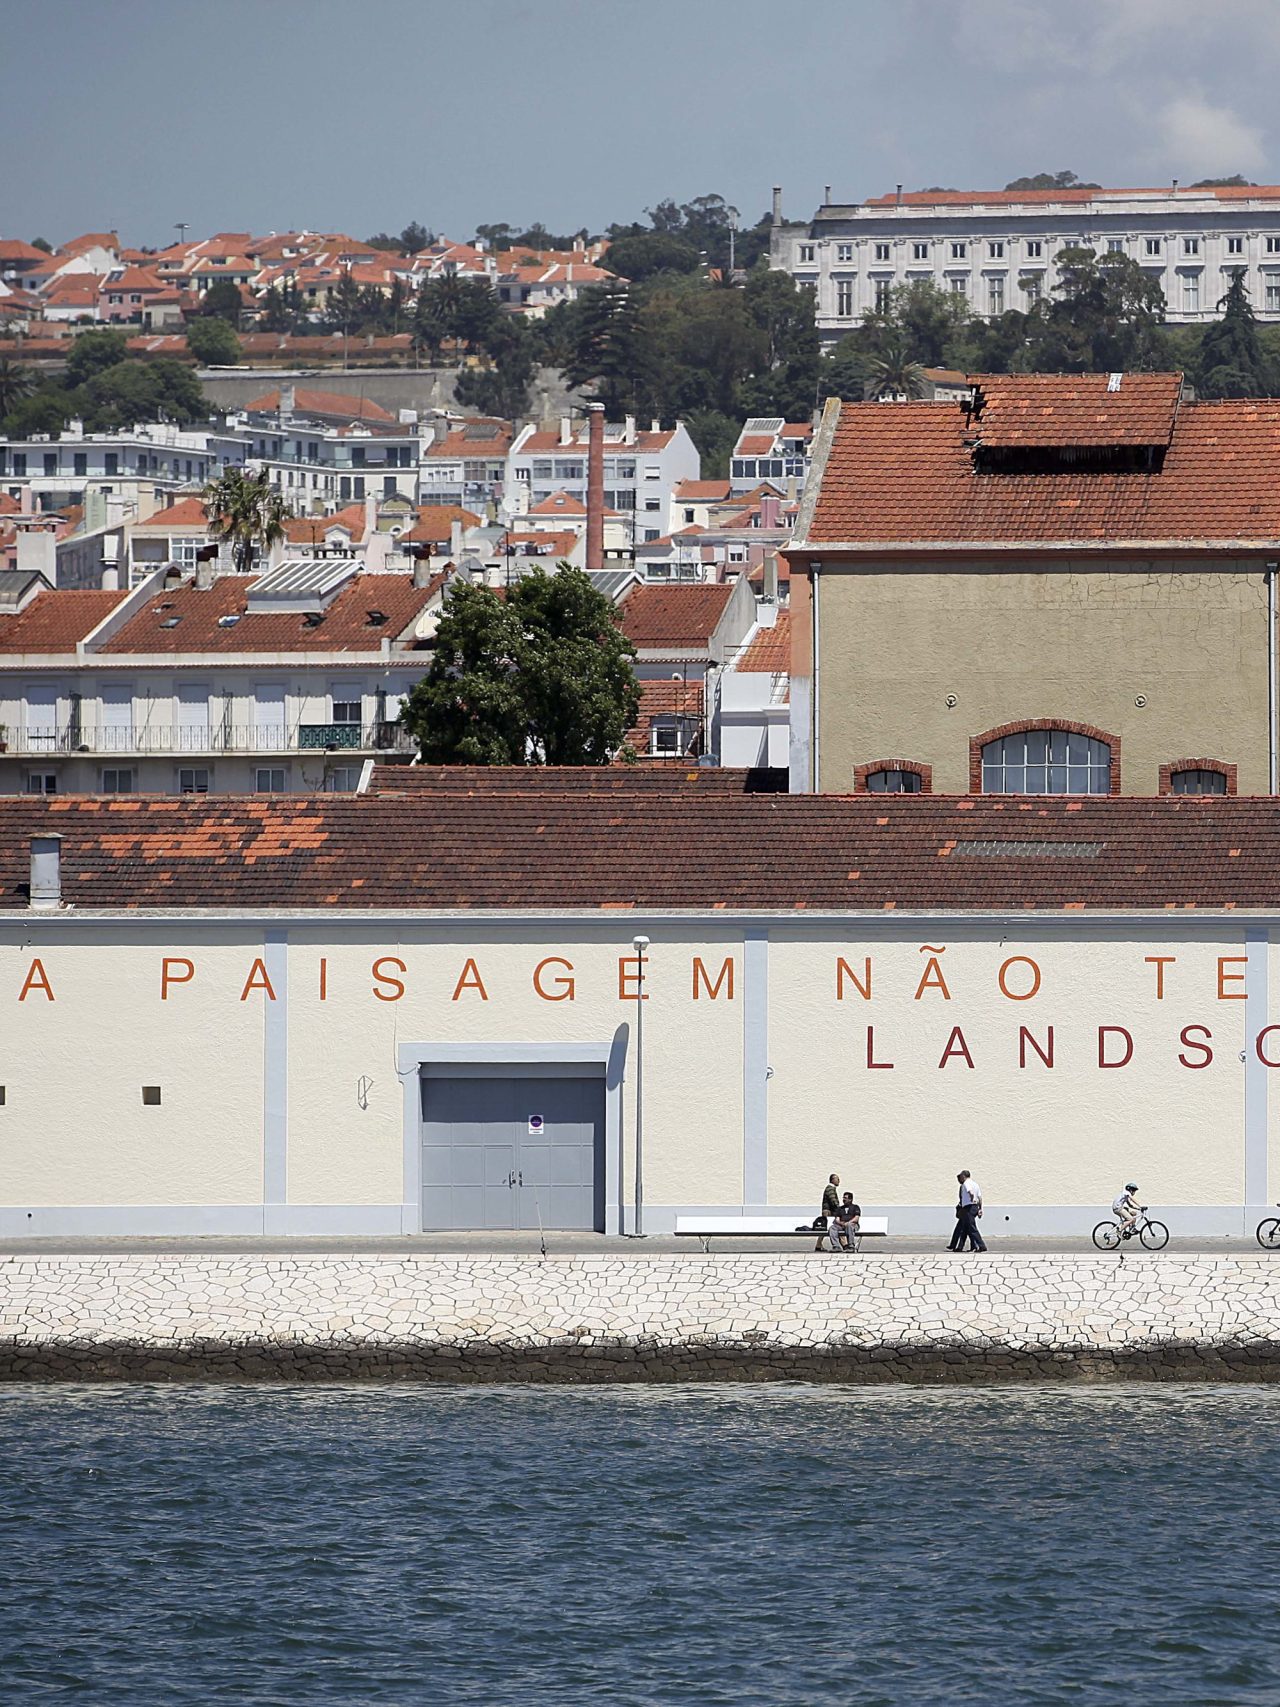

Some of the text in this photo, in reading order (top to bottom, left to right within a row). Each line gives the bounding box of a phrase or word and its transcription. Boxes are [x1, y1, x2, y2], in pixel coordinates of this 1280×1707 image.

[18, 957, 54, 1002] A
[161, 956, 735, 1003] PAISAGEM
[836, 944, 1042, 1001] NÃO
